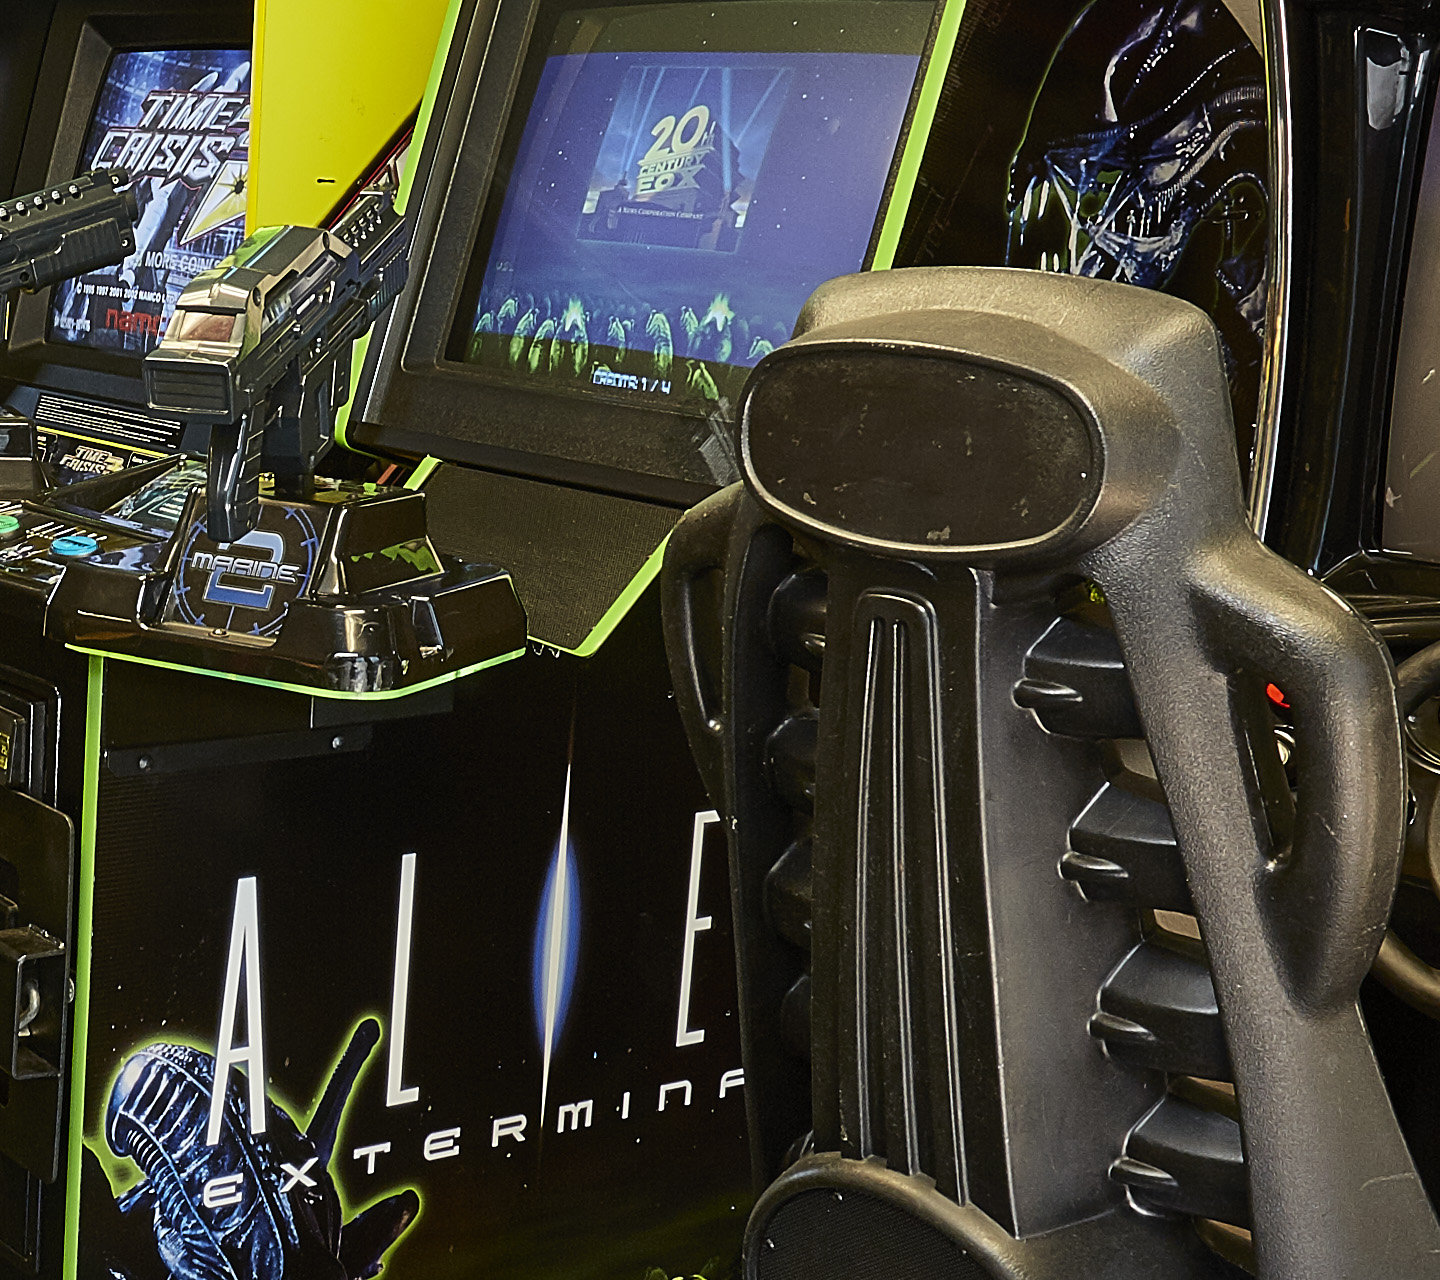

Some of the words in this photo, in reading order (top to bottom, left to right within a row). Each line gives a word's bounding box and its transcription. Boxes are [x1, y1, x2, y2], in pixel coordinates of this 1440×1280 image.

[141, 91, 244, 131] TIME
[91, 131, 236, 181] CRISIS
[640, 152, 709, 175] CENTURY
[636, 169, 701, 195] FOX
[145, 252, 174, 269] MORE
[139, 290, 161, 303] NAMCO
[661, 381, 671, 395] 4
[192, 552, 300, 583] MARINE
